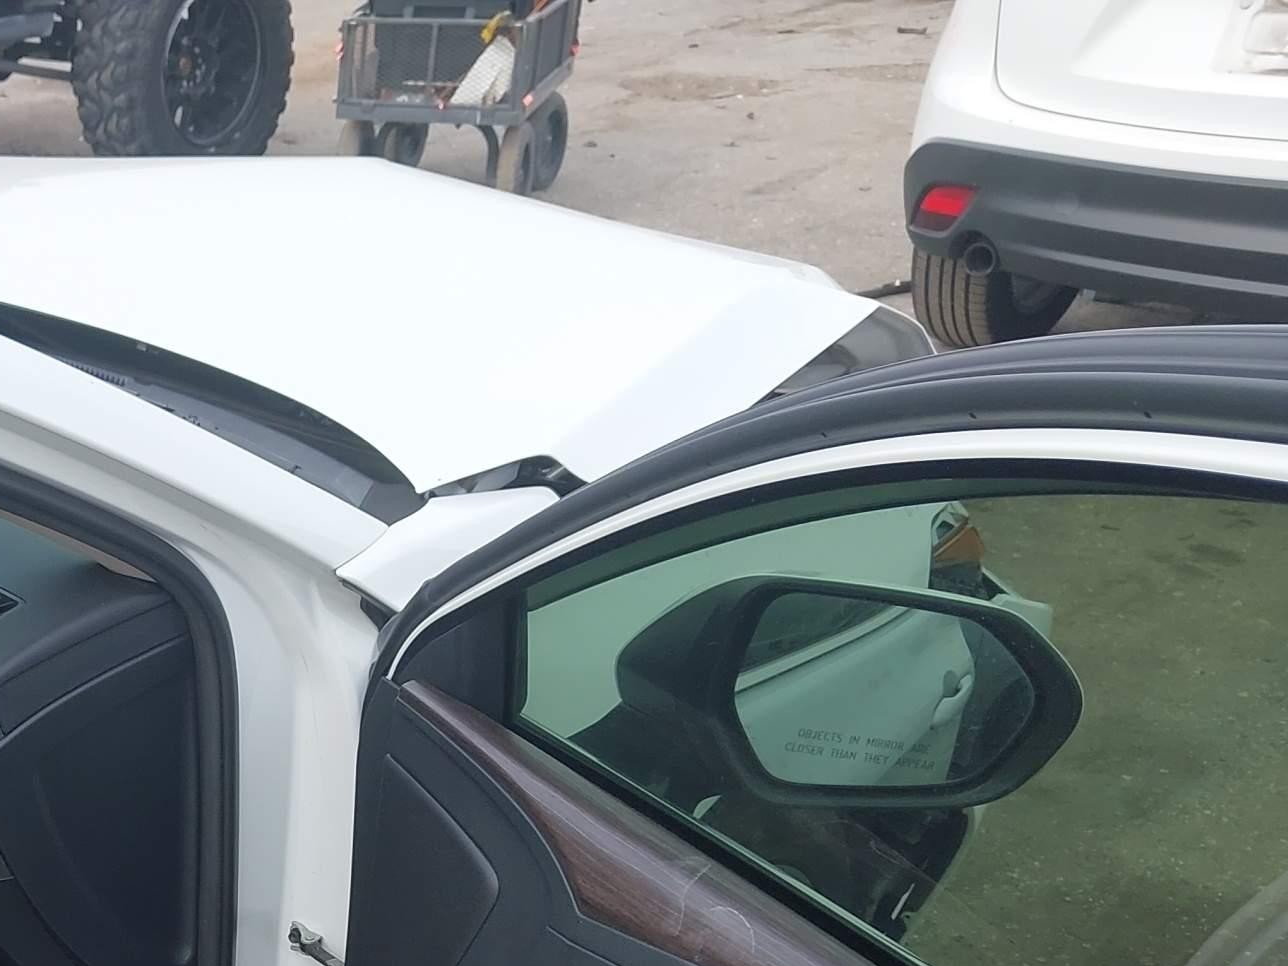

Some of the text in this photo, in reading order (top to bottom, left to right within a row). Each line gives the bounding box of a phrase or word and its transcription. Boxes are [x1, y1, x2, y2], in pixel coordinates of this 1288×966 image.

[798, 728, 842, 743] OBJECTS
[848, 735, 861, 745] IN
[866, 737, 905, 751] MIRROR
[784, 742, 936, 770] CLOSER THAN THEY APPEAR
